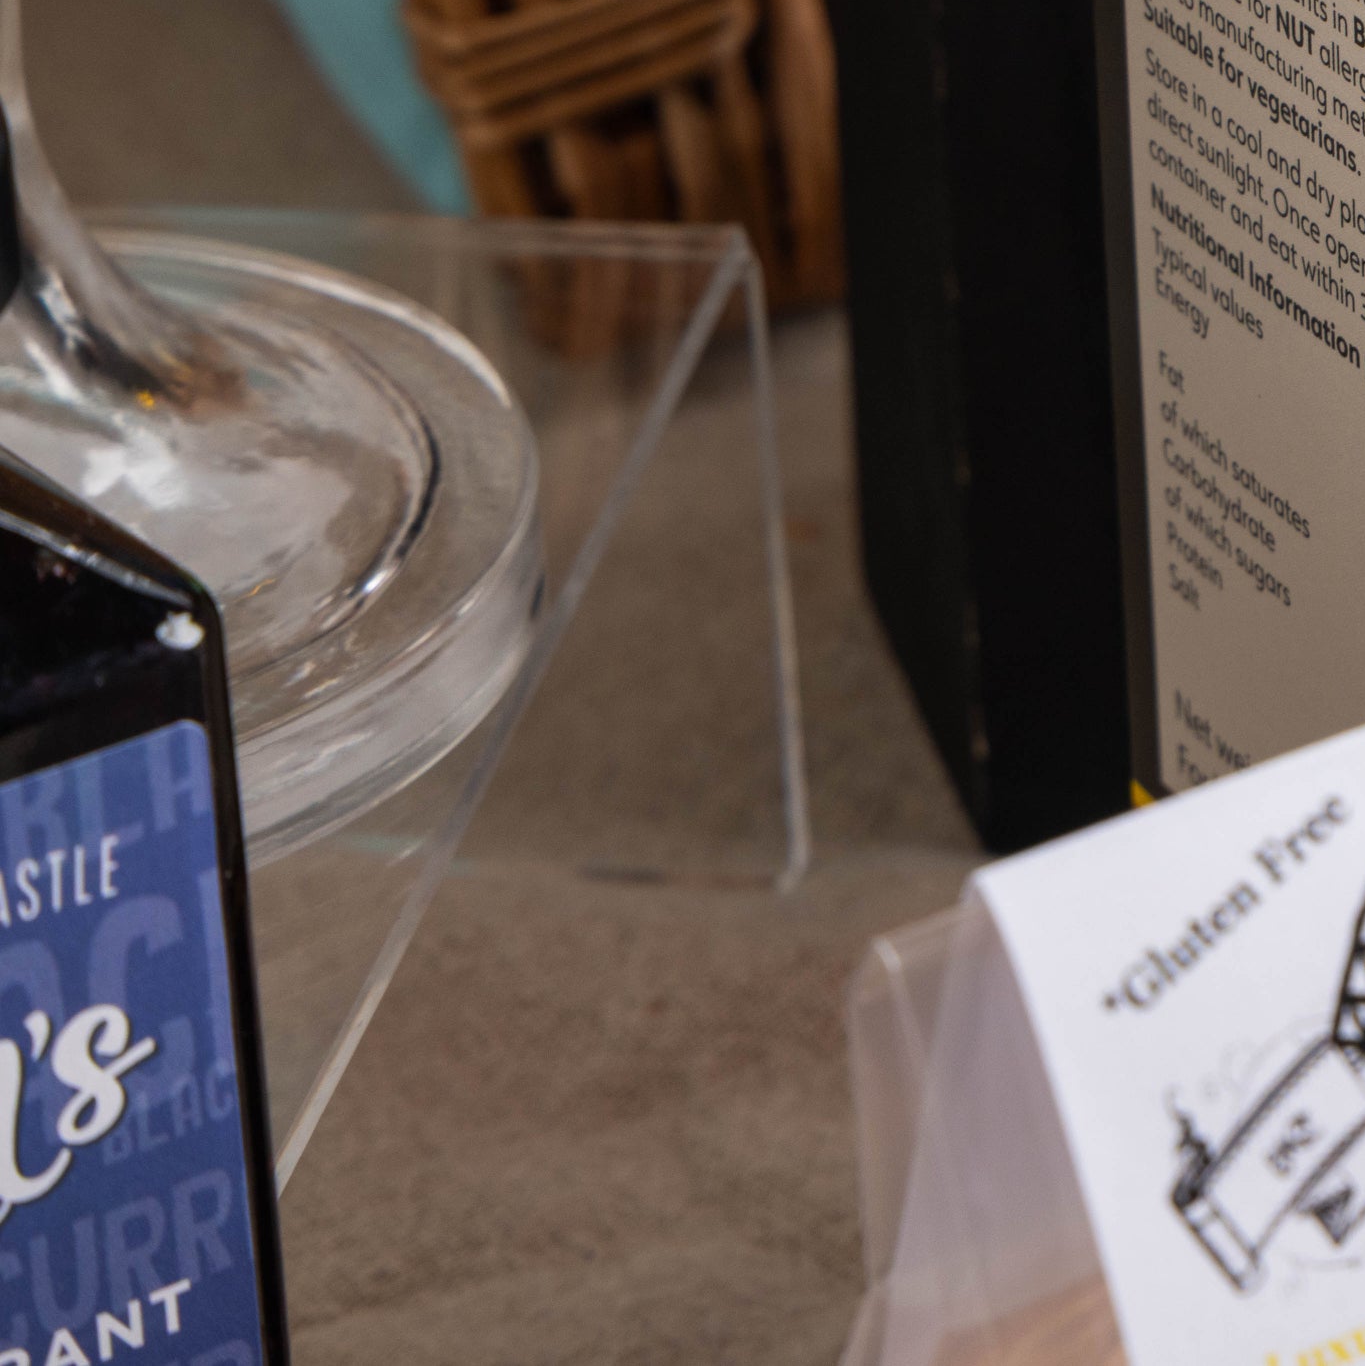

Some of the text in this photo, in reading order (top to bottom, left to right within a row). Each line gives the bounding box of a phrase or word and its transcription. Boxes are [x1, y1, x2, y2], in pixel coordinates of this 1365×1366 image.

[1198, 0, 1328, 117] manufacturing
[1275, 3, 1316, 56] NUT
[1332, 2, 1349, 38] in
[1145, 47, 1189, 103] Store
[1192, 83, 1208, 117] in
[1211, 105, 1223, 129] a
[1226, 117, 1263, 160] cool
[1266, 147, 1302, 189] and
[1305, 169, 1335, 219] dry
[1147, 92, 1194, 149] direct
[1197, 136, 1269, 206] sunlight.
[1272, 187, 1321, 245] Once
[1217, 46, 1244, 89] for
[1247, 76, 1362, 177] vegetarians.
[1148, 139, 1227, 214] container
[1230, 203, 1264, 244] and
[1267, 232, 1298, 271] eat
[1300, 255, 1356, 313] within
[1151, 183, 1245, 281] Nutritional
[1248, 260, 1361, 369] Information
[1151, 225, 1264, 340] Typical values
[1154, 265, 1210, 340] Energy
[1157, 349, 1186, 395] Fat
[1160, 401, 1311, 539] of which saturates
[1162, 437, 1276, 553] Carbohydrate
[1163, 486, 1292, 608] of which sugars
[1251, 794, 1350, 885] Free
